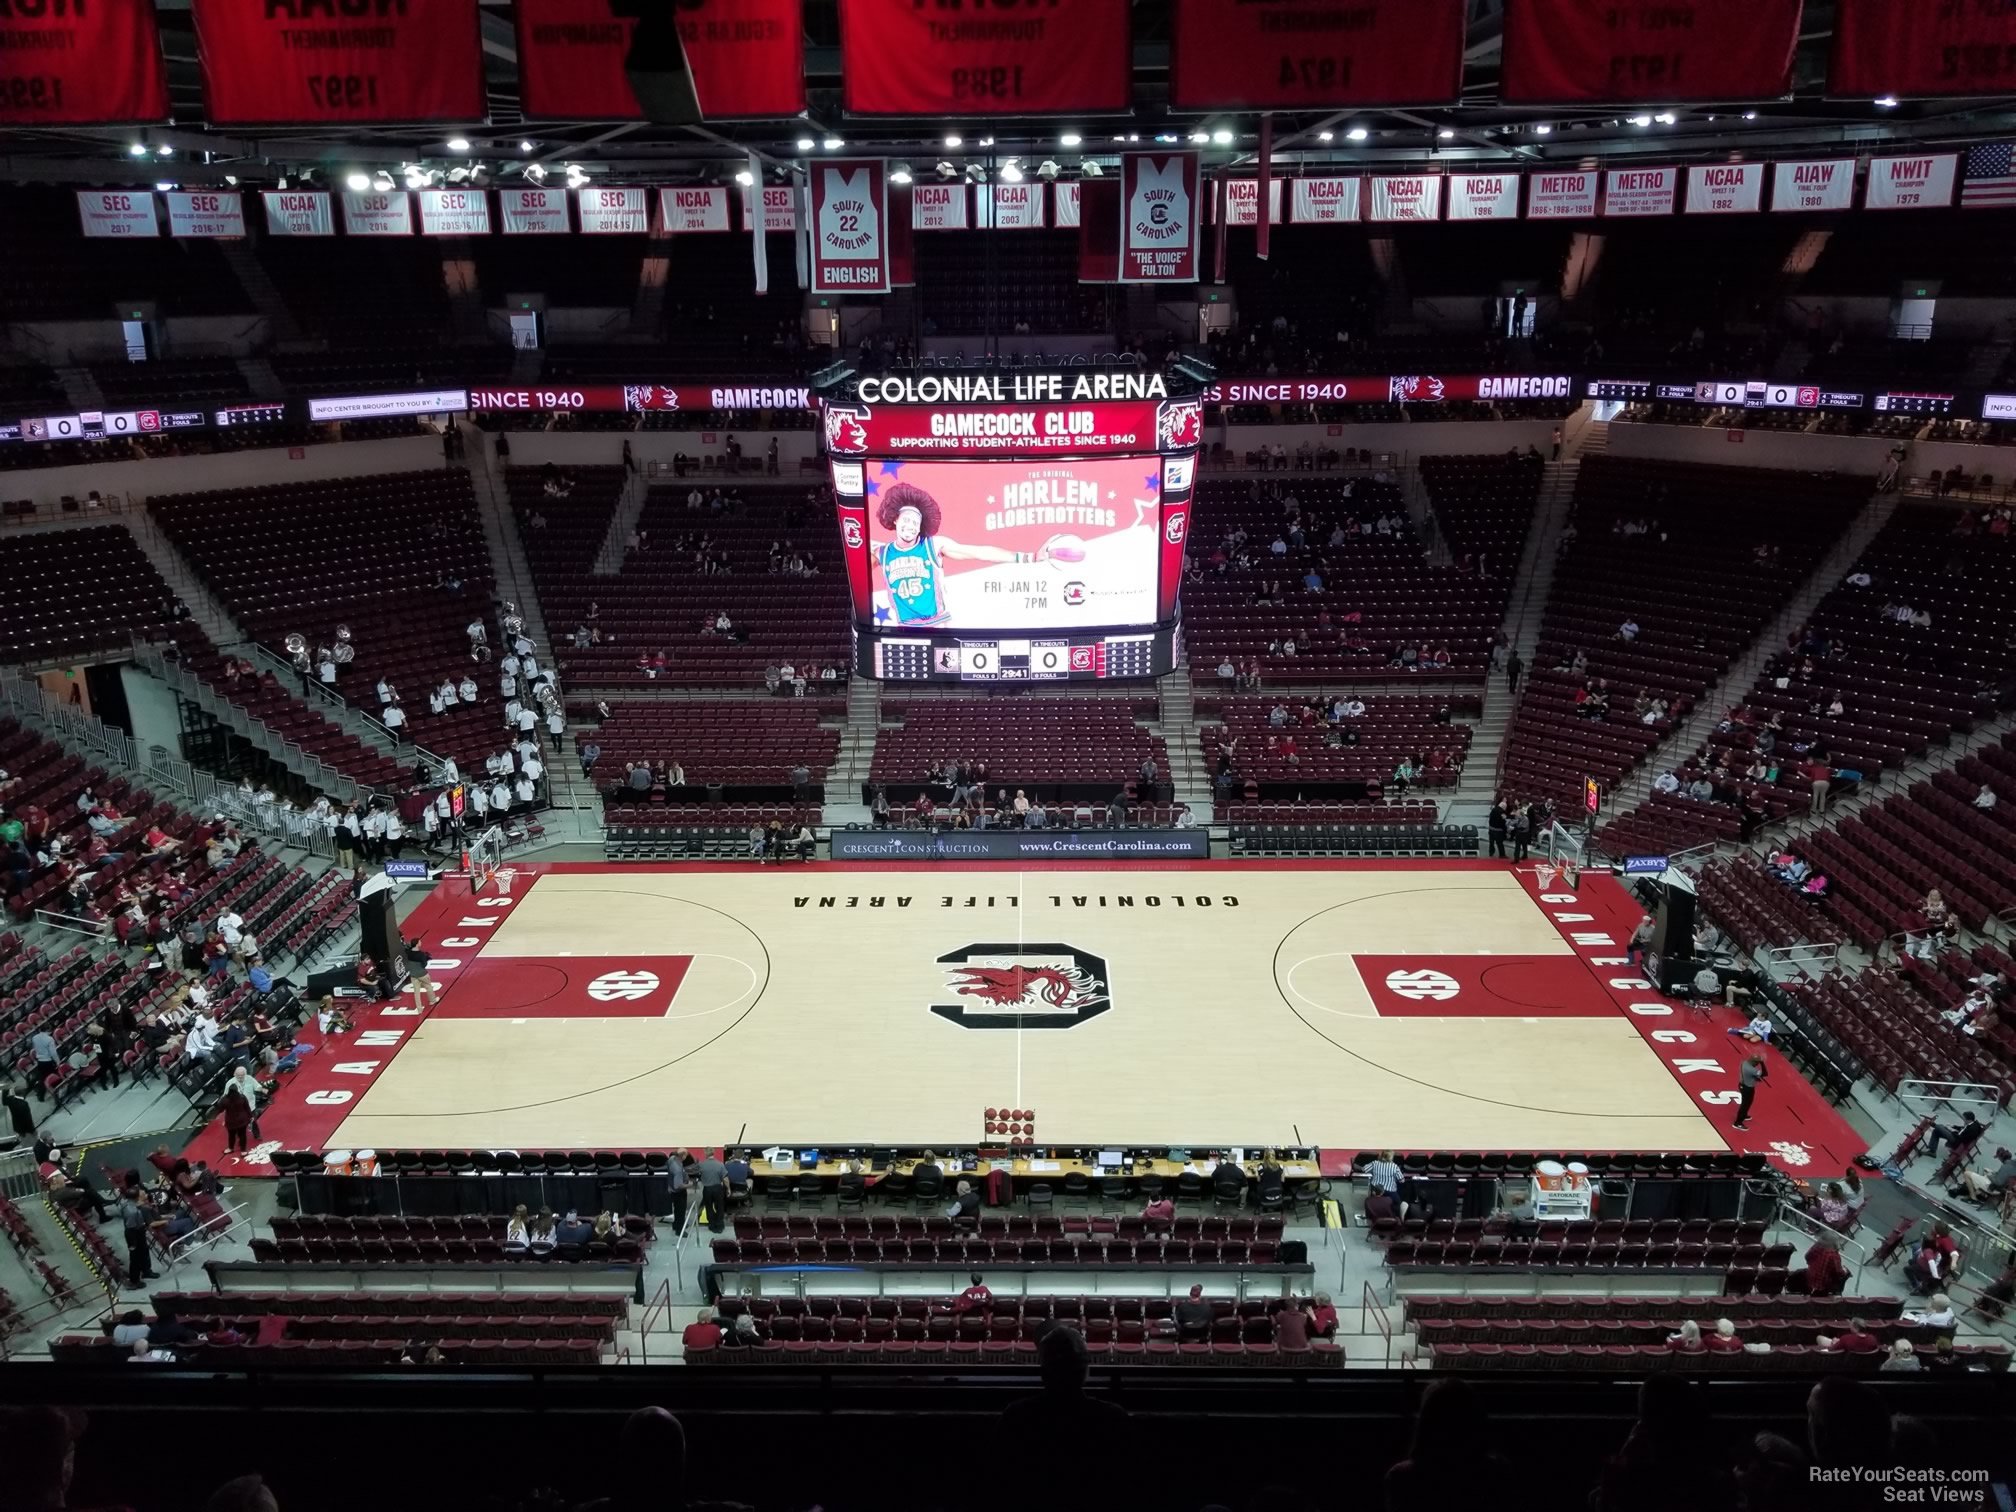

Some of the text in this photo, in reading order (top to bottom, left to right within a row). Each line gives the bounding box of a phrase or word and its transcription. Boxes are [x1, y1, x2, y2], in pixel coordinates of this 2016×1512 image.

[1705, 168, 1744, 186] NCAA
[1794, 165, 1834, 183] AIAW
[1891, 160, 1933, 179] NWIT
[1387, 180, 1423, 196] NCAA
[1466, 179, 1502, 194] NCAA
[1541, 176, 1585, 193] METRO
[1618, 172, 1663, 190] METRO
[915, 189, 950, 204] NCAA
[1143, 188, 1176, 203] SOUTH
[1229, 184, 1258, 199] NCA
[1308, 182, 1344, 197] NCAA
[102, 195, 131, 211] SEC
[191, 196, 219, 211] SEC
[280, 196, 316, 211] NCAA
[364, 196, 388, 210] SEC
[441, 194, 466, 209] SEC
[521, 192, 546, 207] SEC
[601, 192, 625, 207] SEC
[676, 192, 712, 207] NCAA
[763, 191, 787, 206] SEC
[1712, 200, 1732, 208] 1982
[1800, 197, 1822, 206] 1980
[1896, 194, 1920, 204] 1979
[832, 199, 865, 214] SOUTH
[1474, 207, 1492, 216] 1986
[687, 219, 704, 228] 2014
[840, 215, 858, 231] 22
[924, 217, 943, 225] 2012
[1001, 216, 1020, 224] 2003
[1238, 212, 1256, 220] 1990
[111, 224, 131, 233] 2017
[369, 223, 388, 231] 2016
[528, 221, 545, 230] 2015
[1136, 220, 1183, 240] CAROLINA
[826, 231, 872, 250] CAROLINA
[1131, 251, 1187, 264] "THE VOICE"
[823, 266, 879, 284] ENGLISH
[1141, 264, 1175, 276] FULTON
[858, 373, 1167, 402] COLONIAL LIFE ARENA
[1229, 385, 1291, 401] SINCE
[1299, 384, 1347, 400] 1940
[1725, 387, 1736, 400] 0
[471, 391, 530, 408] SINCE
[536, 391, 584, 408] 1940
[711, 388, 810, 409] GAMECOCK
[1775, 389, 1787, 403] 0
[334, 404, 361, 412] CENTER
[362, 402, 393, 410] BROUGHT
[58, 421, 71, 435] 0
[115, 416, 127, 430] 0
[930, 411, 1094, 437] GAMECOCK CLUB
[890, 434, 1136, 448] SUPPORTING STUDENT-ATHLETES SINCE 1940
[1043, 470, 1074, 479] ORIGINAL
[1003, 481, 1098, 509] HARLEM
[985, 507, 1116, 531] GLOBETROTTERS
[898, 578, 924, 599] 45
[984, 580, 1048, 594] FRI JAN 12
[1024, 597, 1048, 609] 7PM
[972, 653, 987, 669] 0
[1043, 652, 1057, 668] 0
[1001, 669, 1028, 678] 29:41
[843, 844, 989, 854] CRESCENT CONSTRUCTION
[1020, 840, 1192, 852] www.CrescentCarolina.com
[387, 864, 425, 873] ZAXBY'S
[1627, 859, 1667, 868] ZAXBY'S
[793, 895, 1239, 910] COLONIAL LIFE ARENA
[1540, 893, 1742, 1105] GAMECOCKS
